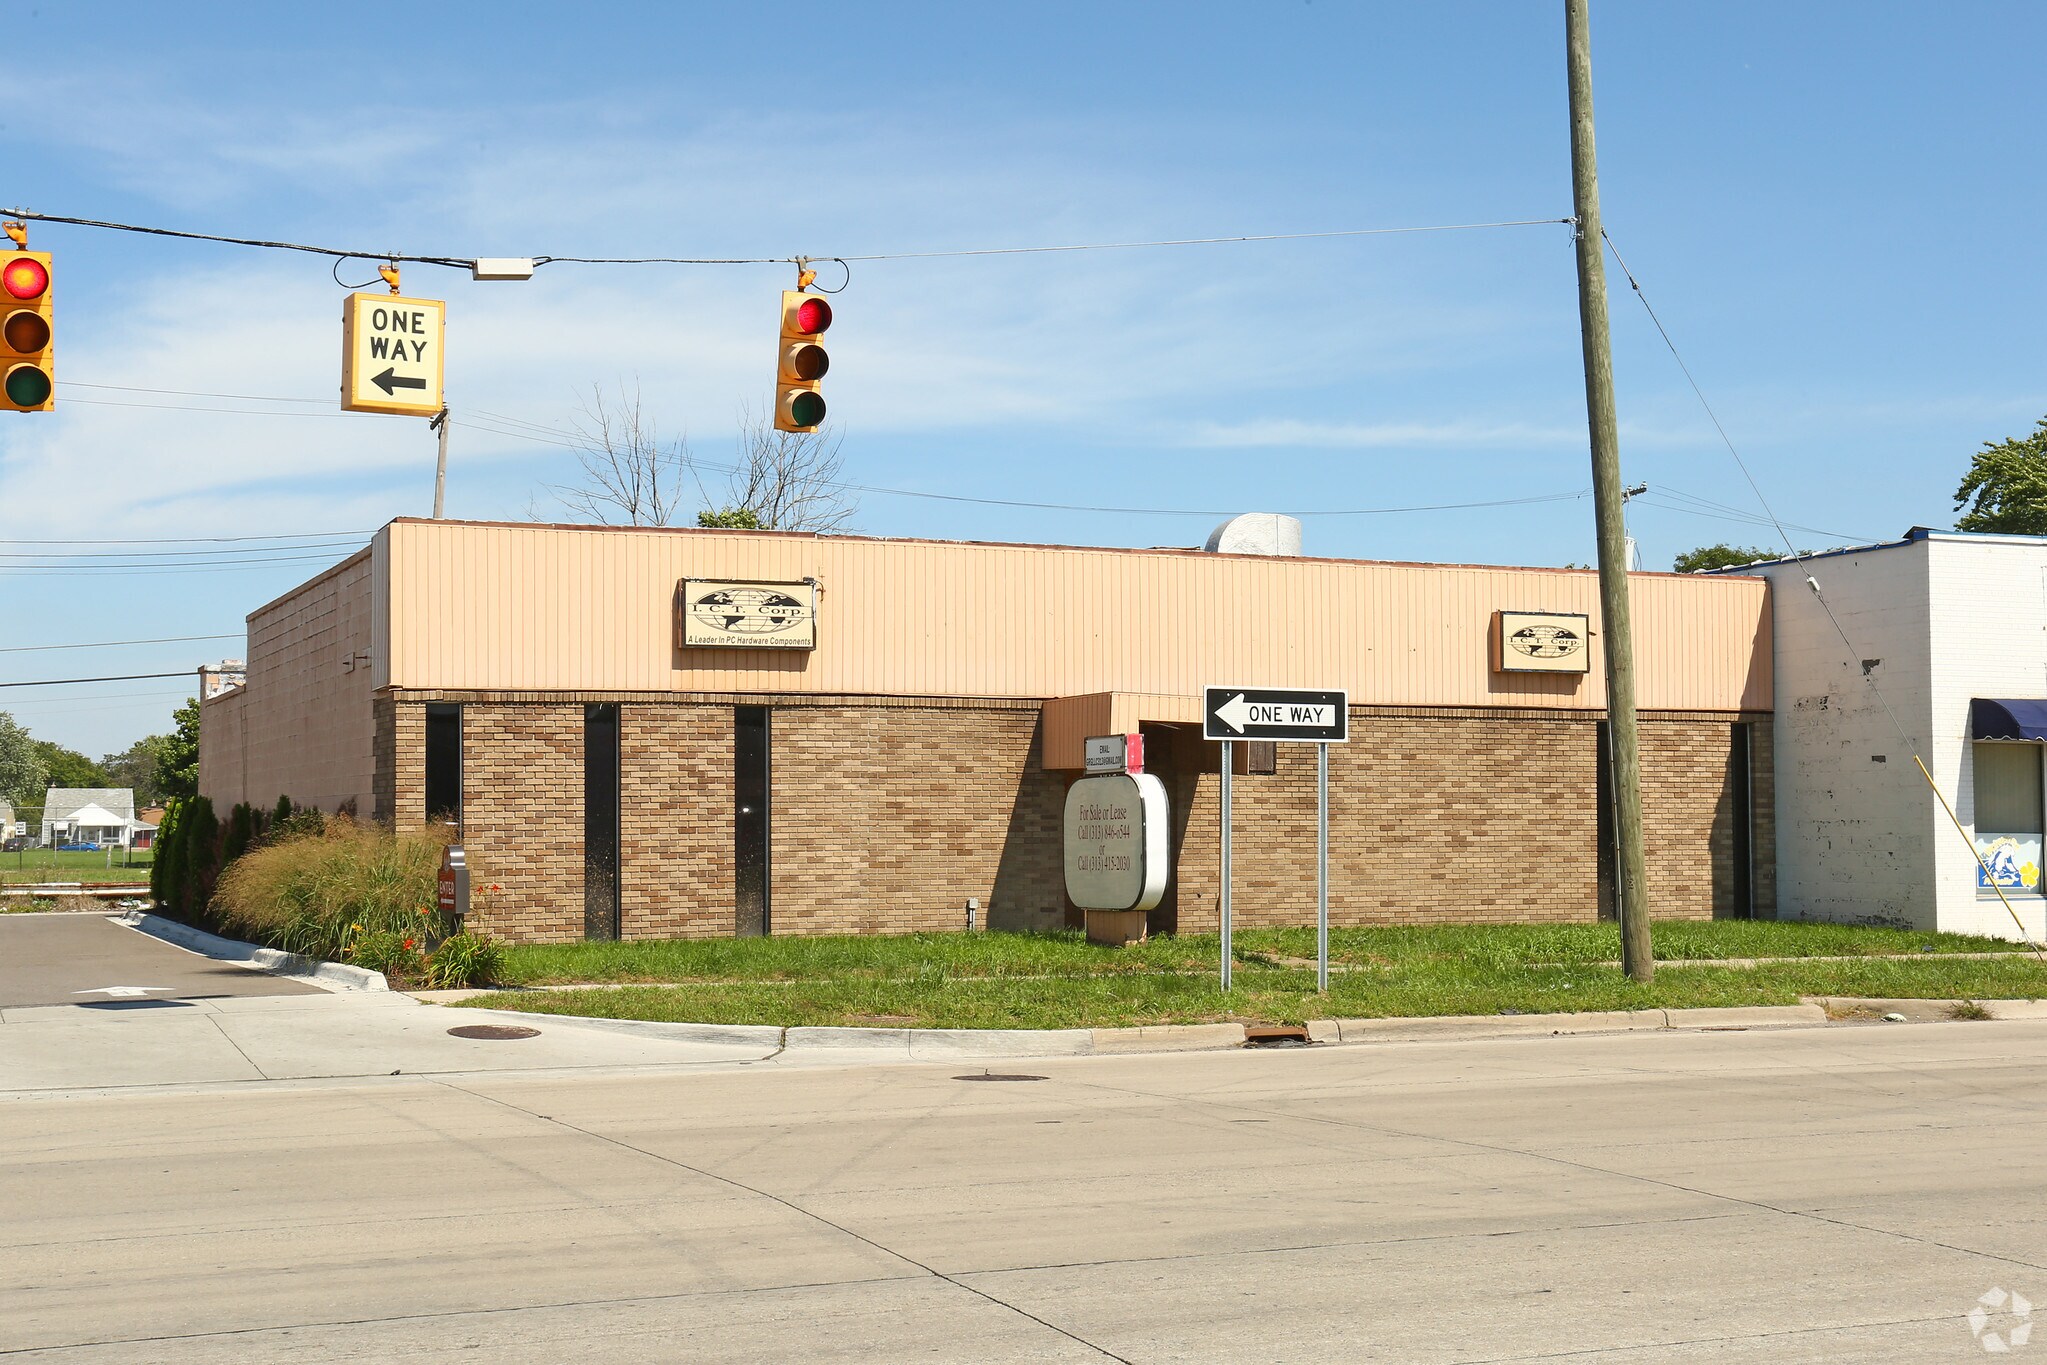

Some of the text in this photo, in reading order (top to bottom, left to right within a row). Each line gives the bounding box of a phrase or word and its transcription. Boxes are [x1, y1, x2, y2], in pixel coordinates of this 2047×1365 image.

[372, 308, 425, 334] ONE
[370, 336, 427, 362] WAY
[758, 606, 805, 617] Corp.
[688, 635, 693, 643] A
[695, 635, 717, 644] Leader
[726, 636, 736, 644] PC
[737, 636, 768, 645] Hardware
[770, 637, 811, 647] Components
[1550, 638, 1580, 646] Corp.
[1249, 705, 1324, 723] ONE WAY
[1080, 804, 1127, 820] For Sale or Lease
[1078, 825, 1088, 839] Call
[1089, 825, 1104, 842] (313)
[1099, 845, 1105, 855] or
[1078, 855, 1088, 871] Call
[1089, 855, 1104, 873] (313)
[440, 881, 454, 895] ENTER
